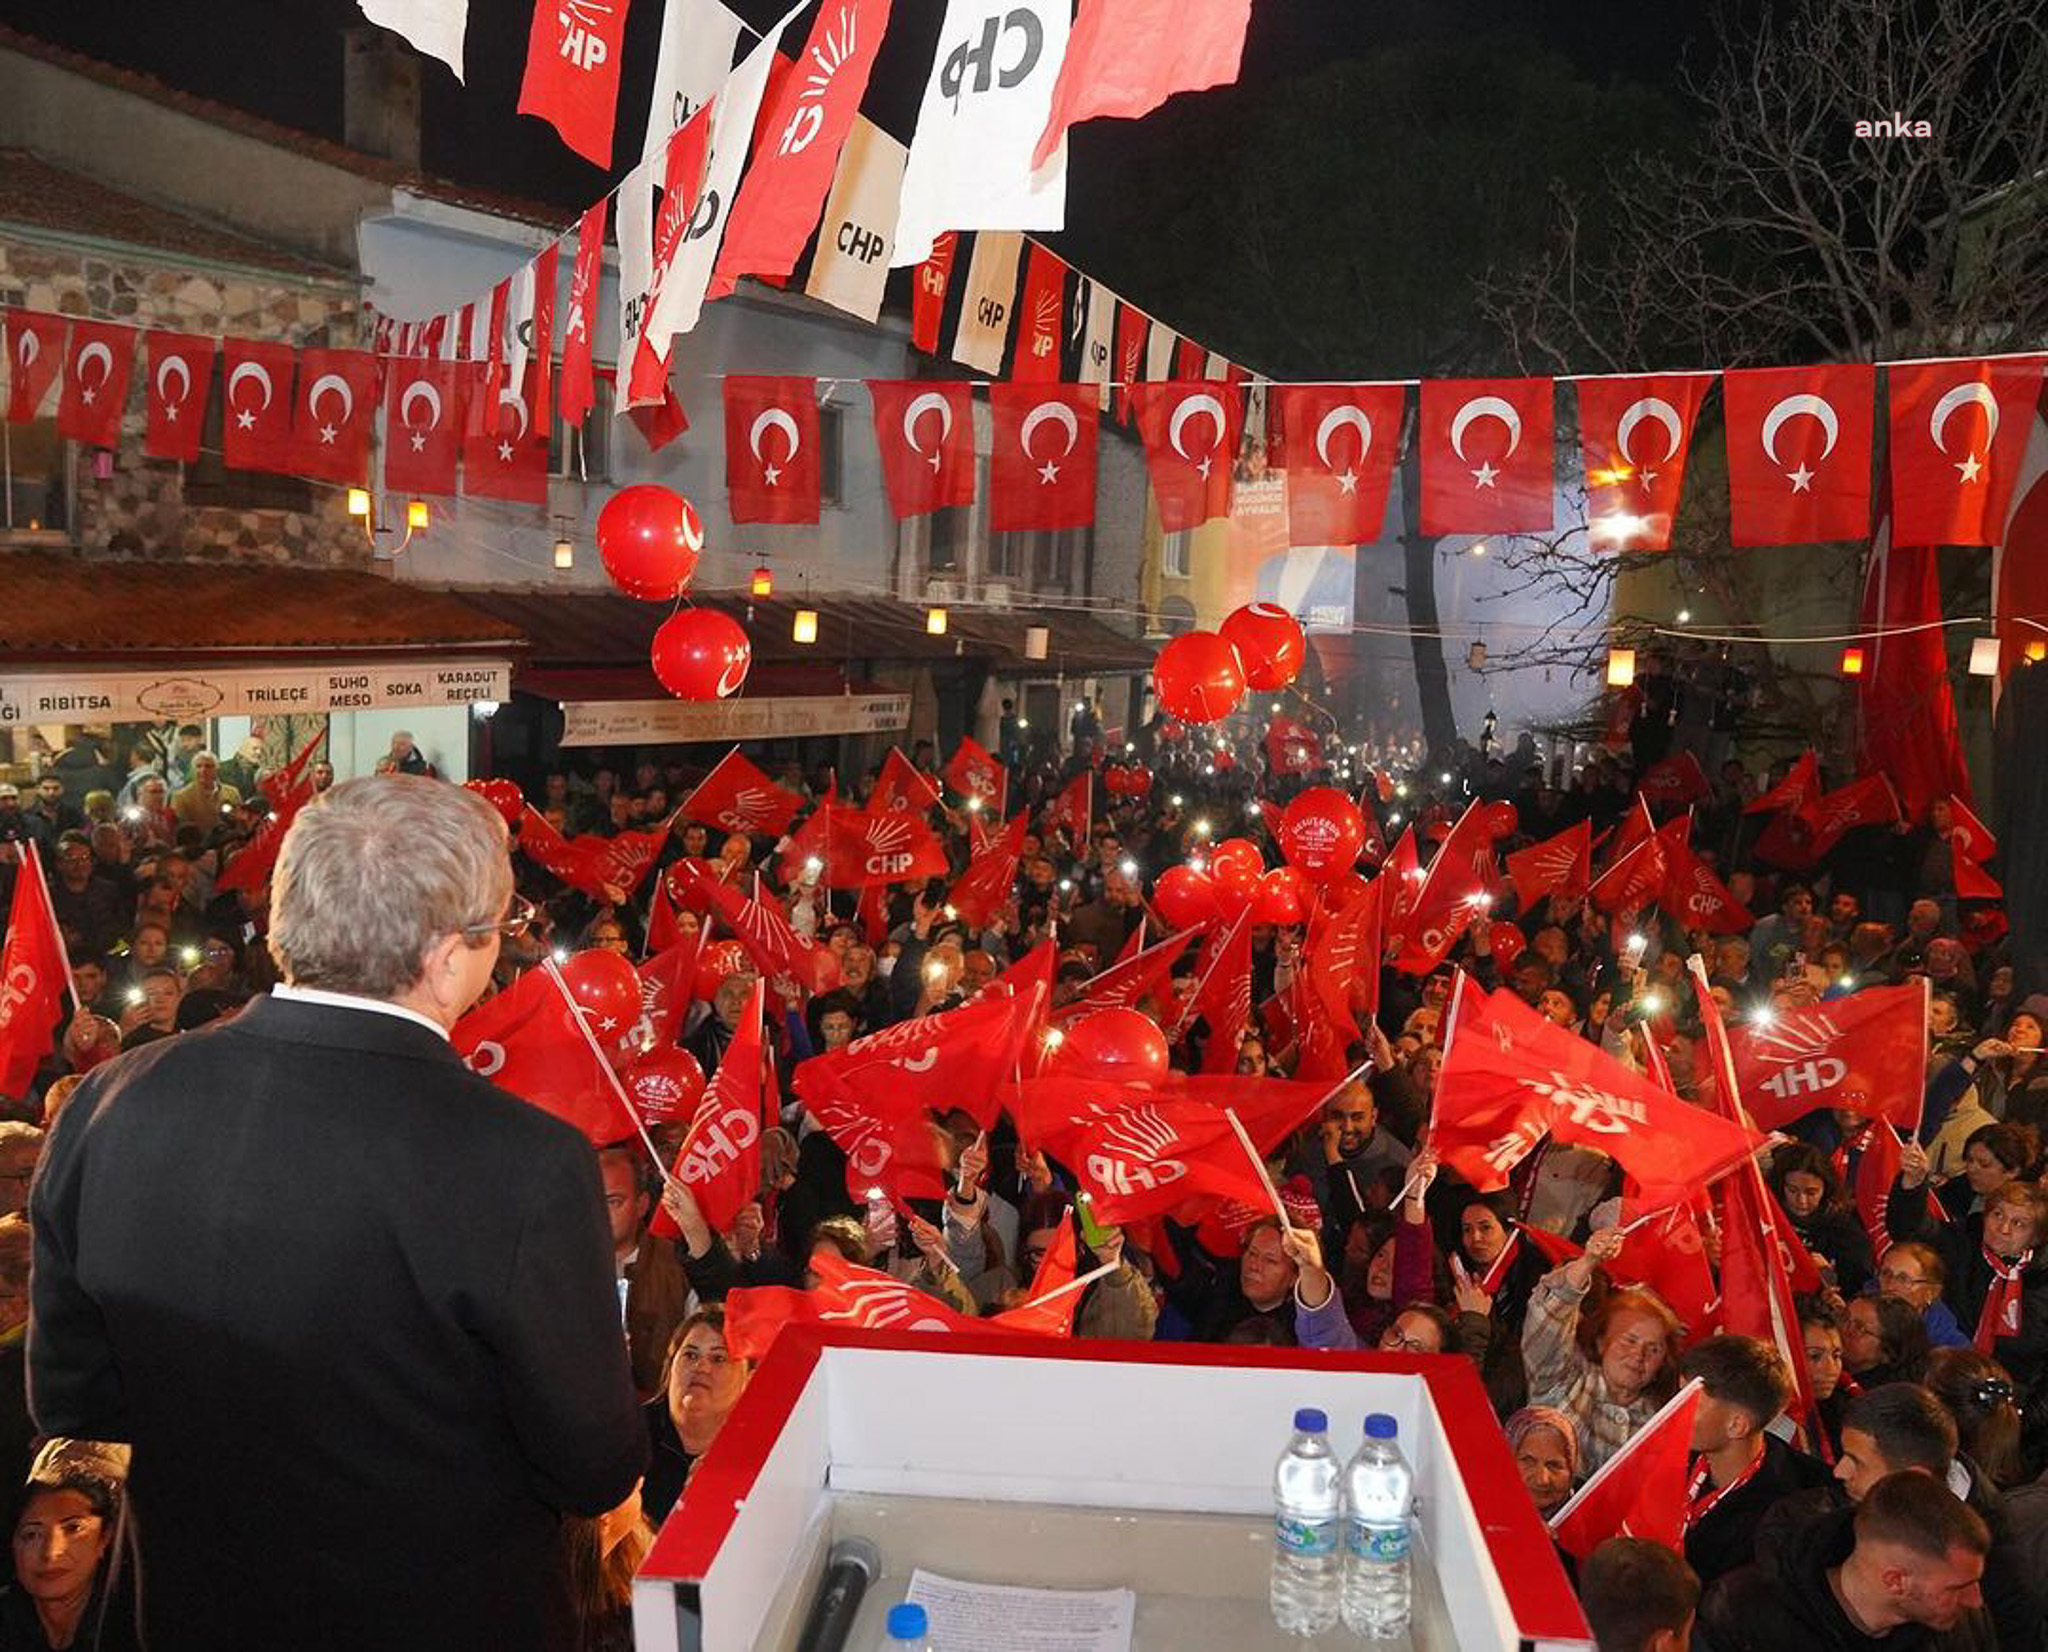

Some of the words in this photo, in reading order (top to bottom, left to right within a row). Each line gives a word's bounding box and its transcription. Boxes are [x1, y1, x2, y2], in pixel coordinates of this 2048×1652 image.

[558, 10, 608, 72] HP
[836, 221, 884, 265] CHP
[978, 296, 1004, 329] CHP
[329, 677, 369, 690] SUHO
[437, 671, 498, 684] KARADUT
[246, 686, 309, 702] TRİLEÇE
[386, 683, 423, 697] SOKA
[446, 686, 491, 701] REÇELİ
[39, 693, 112, 711] RİBİTSA
[329, 694, 372, 707] MESO
[866, 852, 914, 874] CHP
[1688, 893, 1723, 915] CHP
